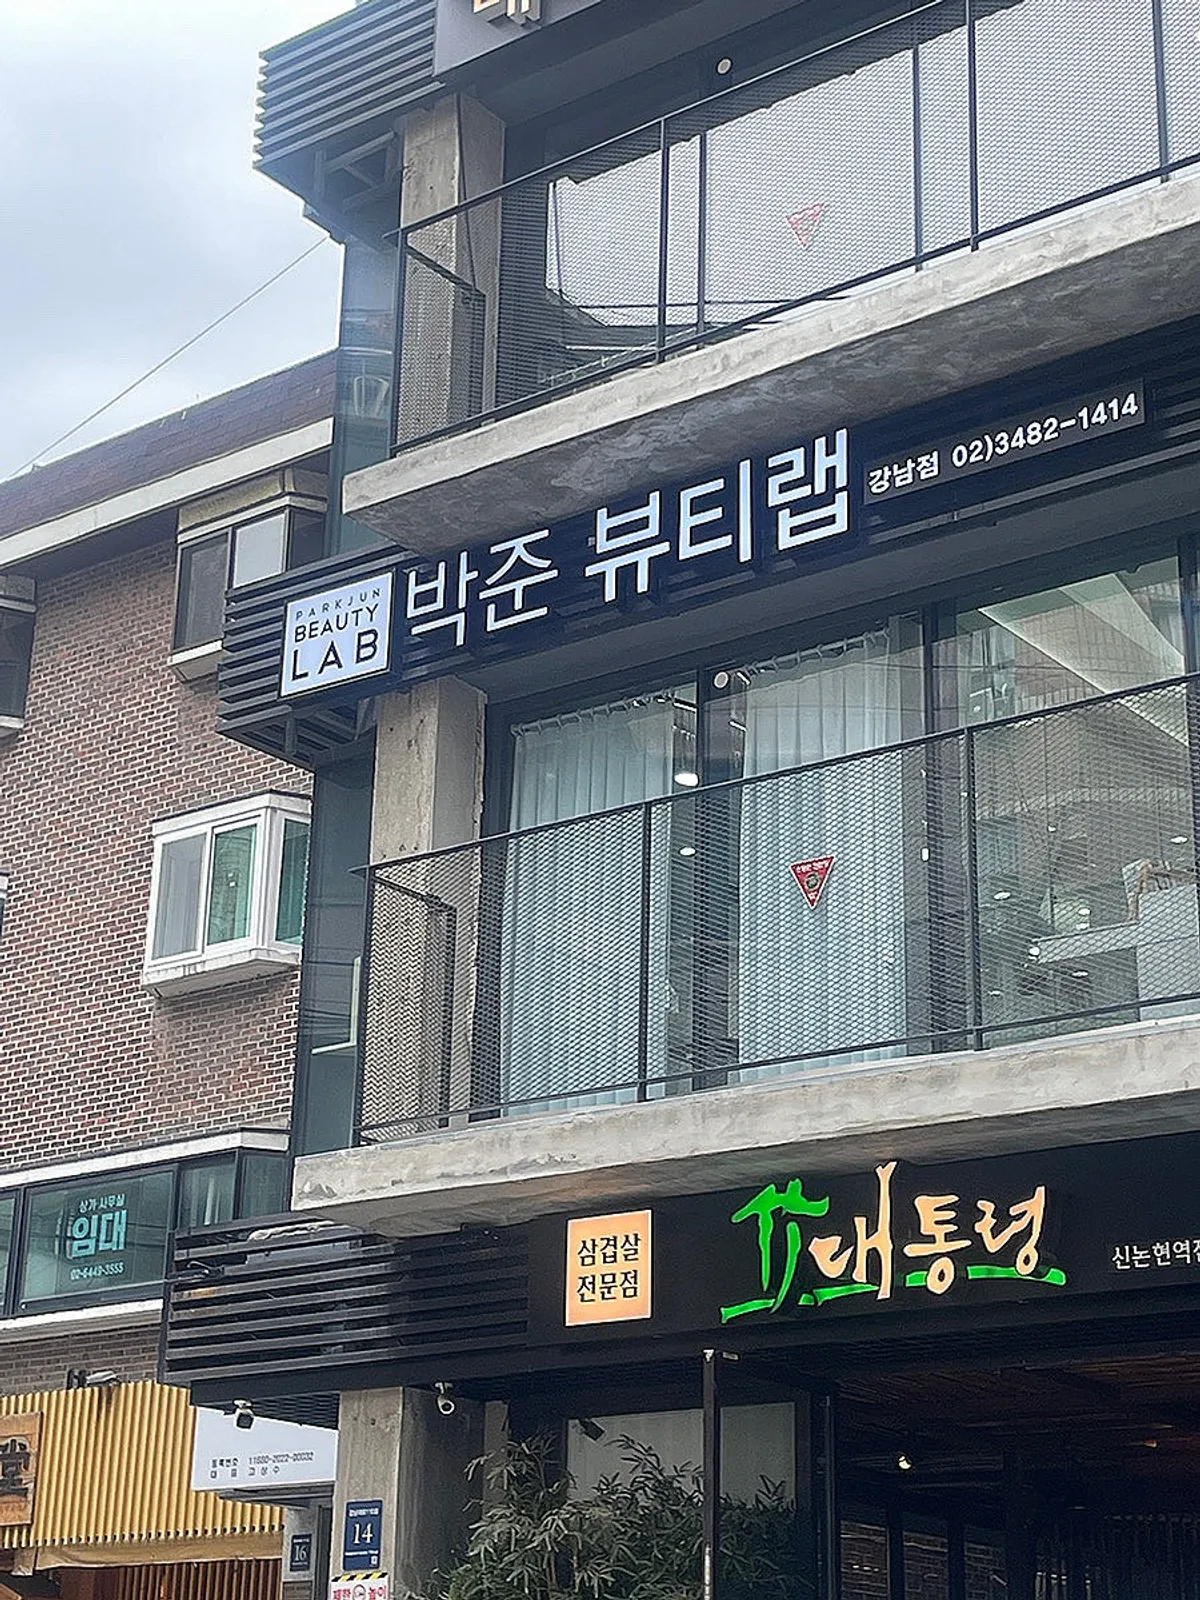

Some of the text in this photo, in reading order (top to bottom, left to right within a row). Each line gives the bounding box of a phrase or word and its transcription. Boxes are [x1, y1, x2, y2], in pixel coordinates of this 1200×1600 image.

[867, 392, 1139, 494] 강남점 02)3482-1414
[406, 427, 849, 647] 박준 뷰티랩
[294, 603, 379, 643] BEAUTY
[296, 588, 381, 621] PARKJUN
[291, 628, 379, 682] LAB
[71, 1210, 128, 1258] 임대
[577, 1232, 641, 1267] 삼겹살
[808, 1161, 1046, 1301] 대통령
[577, 1269, 639, 1303] 전문점
[294, 1545, 307, 1561] 16
[352, 1523, 374, 1545] 14
